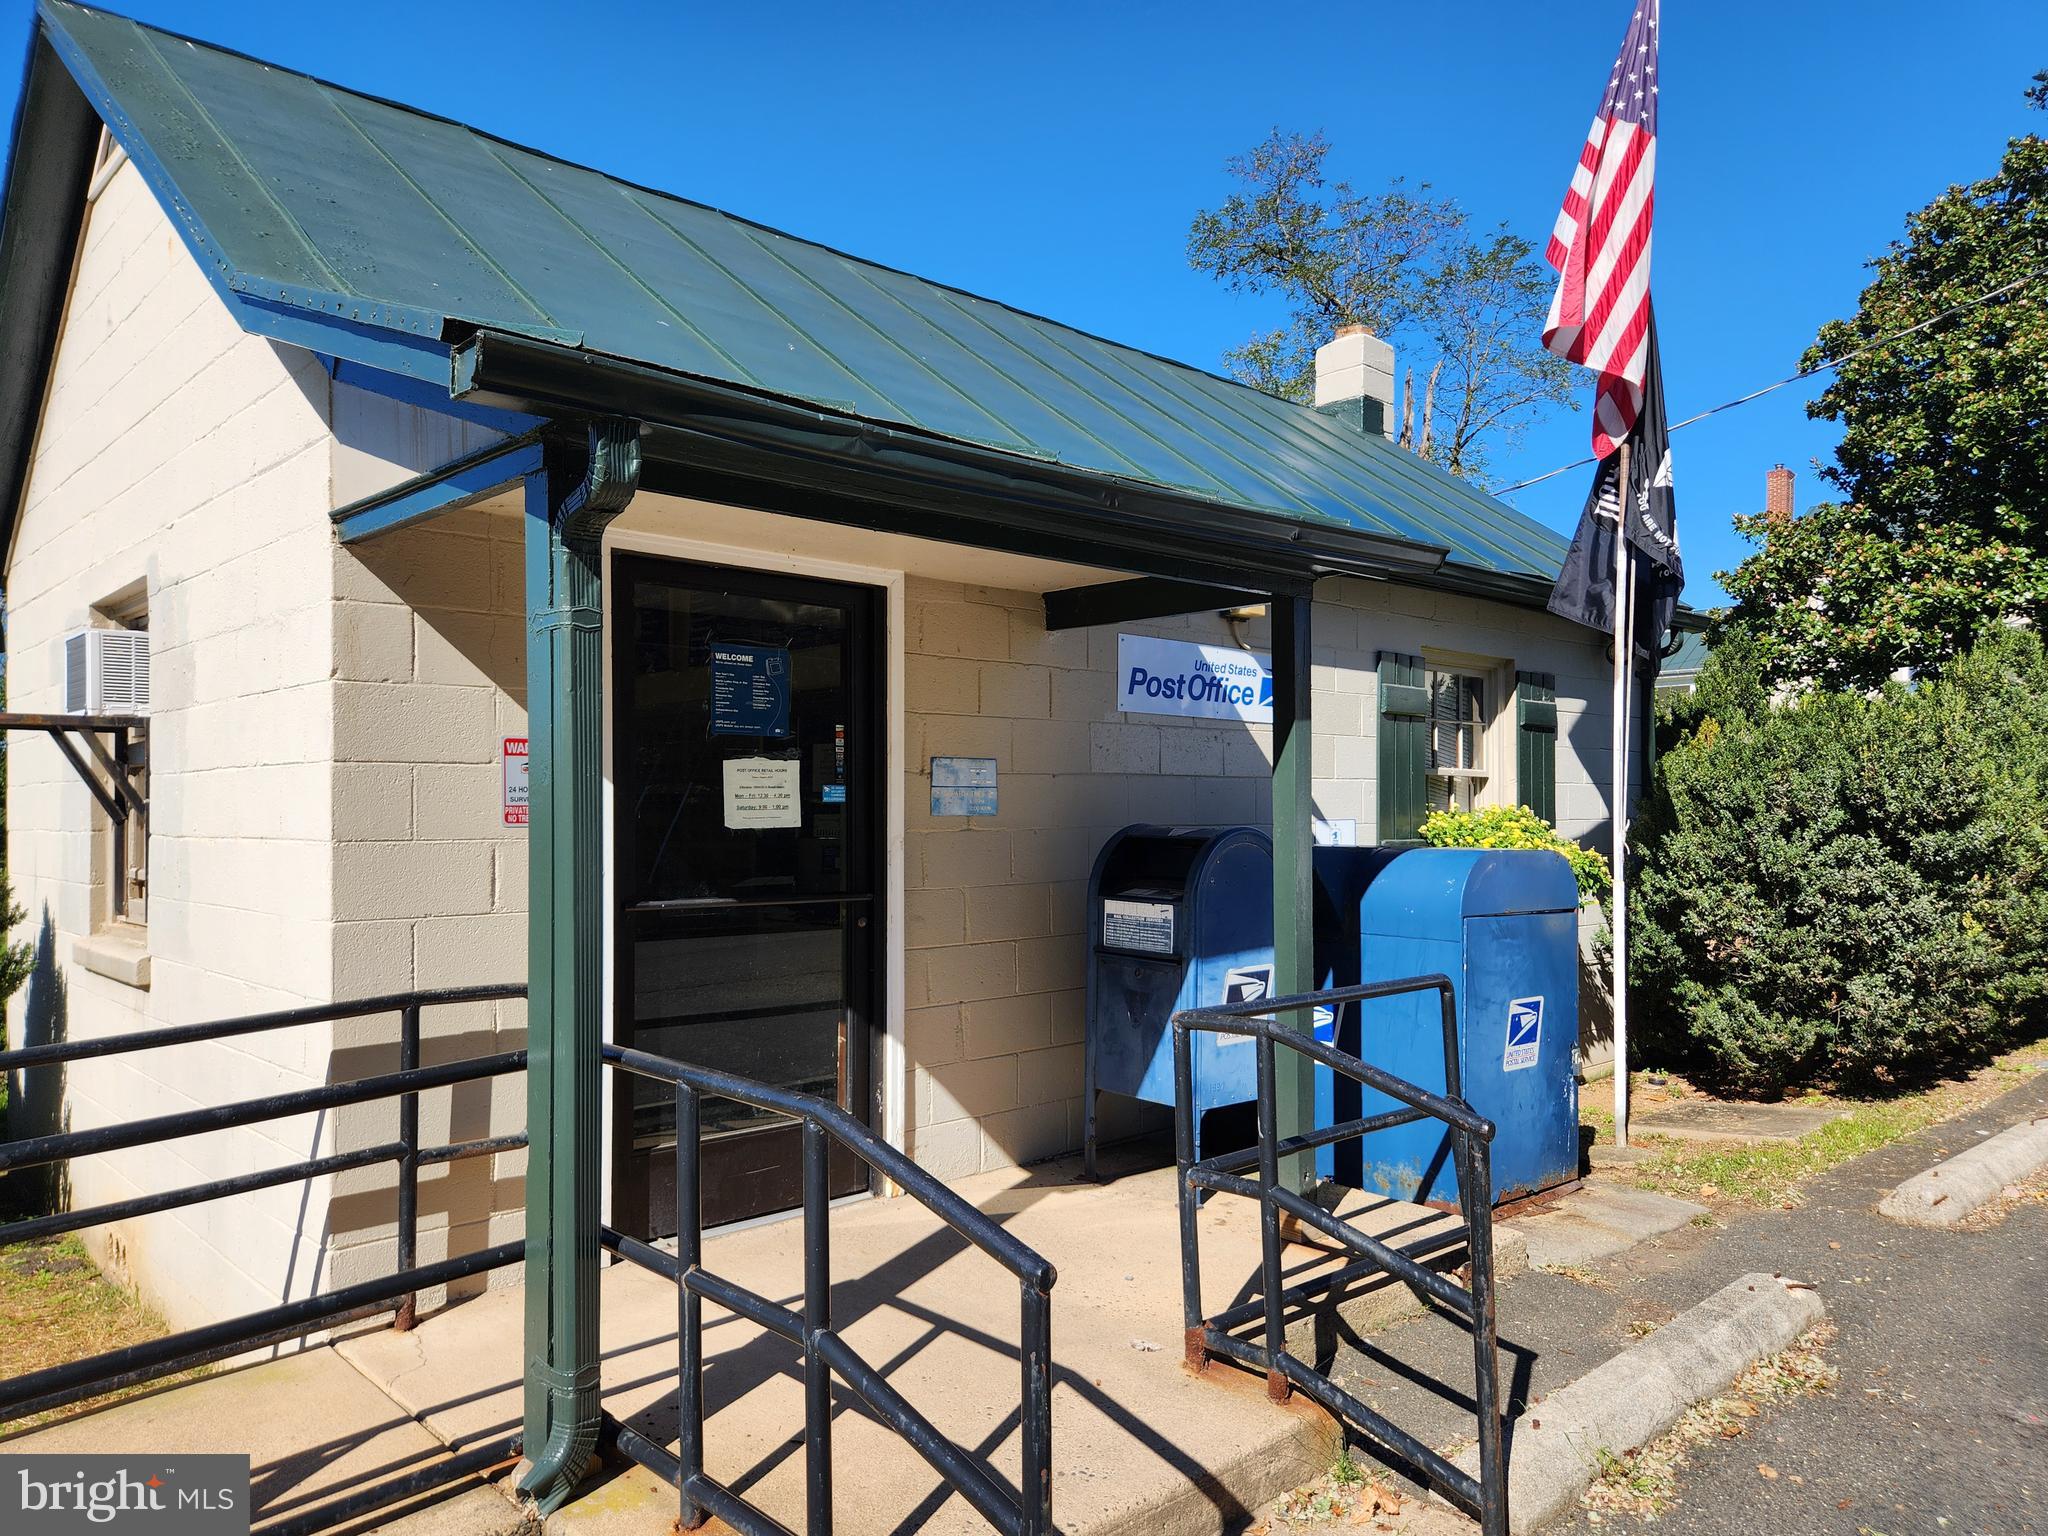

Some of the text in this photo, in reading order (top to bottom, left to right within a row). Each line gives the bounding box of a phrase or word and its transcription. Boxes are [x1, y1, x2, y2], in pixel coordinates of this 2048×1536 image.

[1642, 513, 1658, 532] ARE
[1653, 530, 1672, 547] NOT
[714, 652, 754, 663] WELCOME
[1194, 659, 1257, 678] United States
[1127, 667, 1255, 706] Post Office
[507, 815, 517, 823] NO
